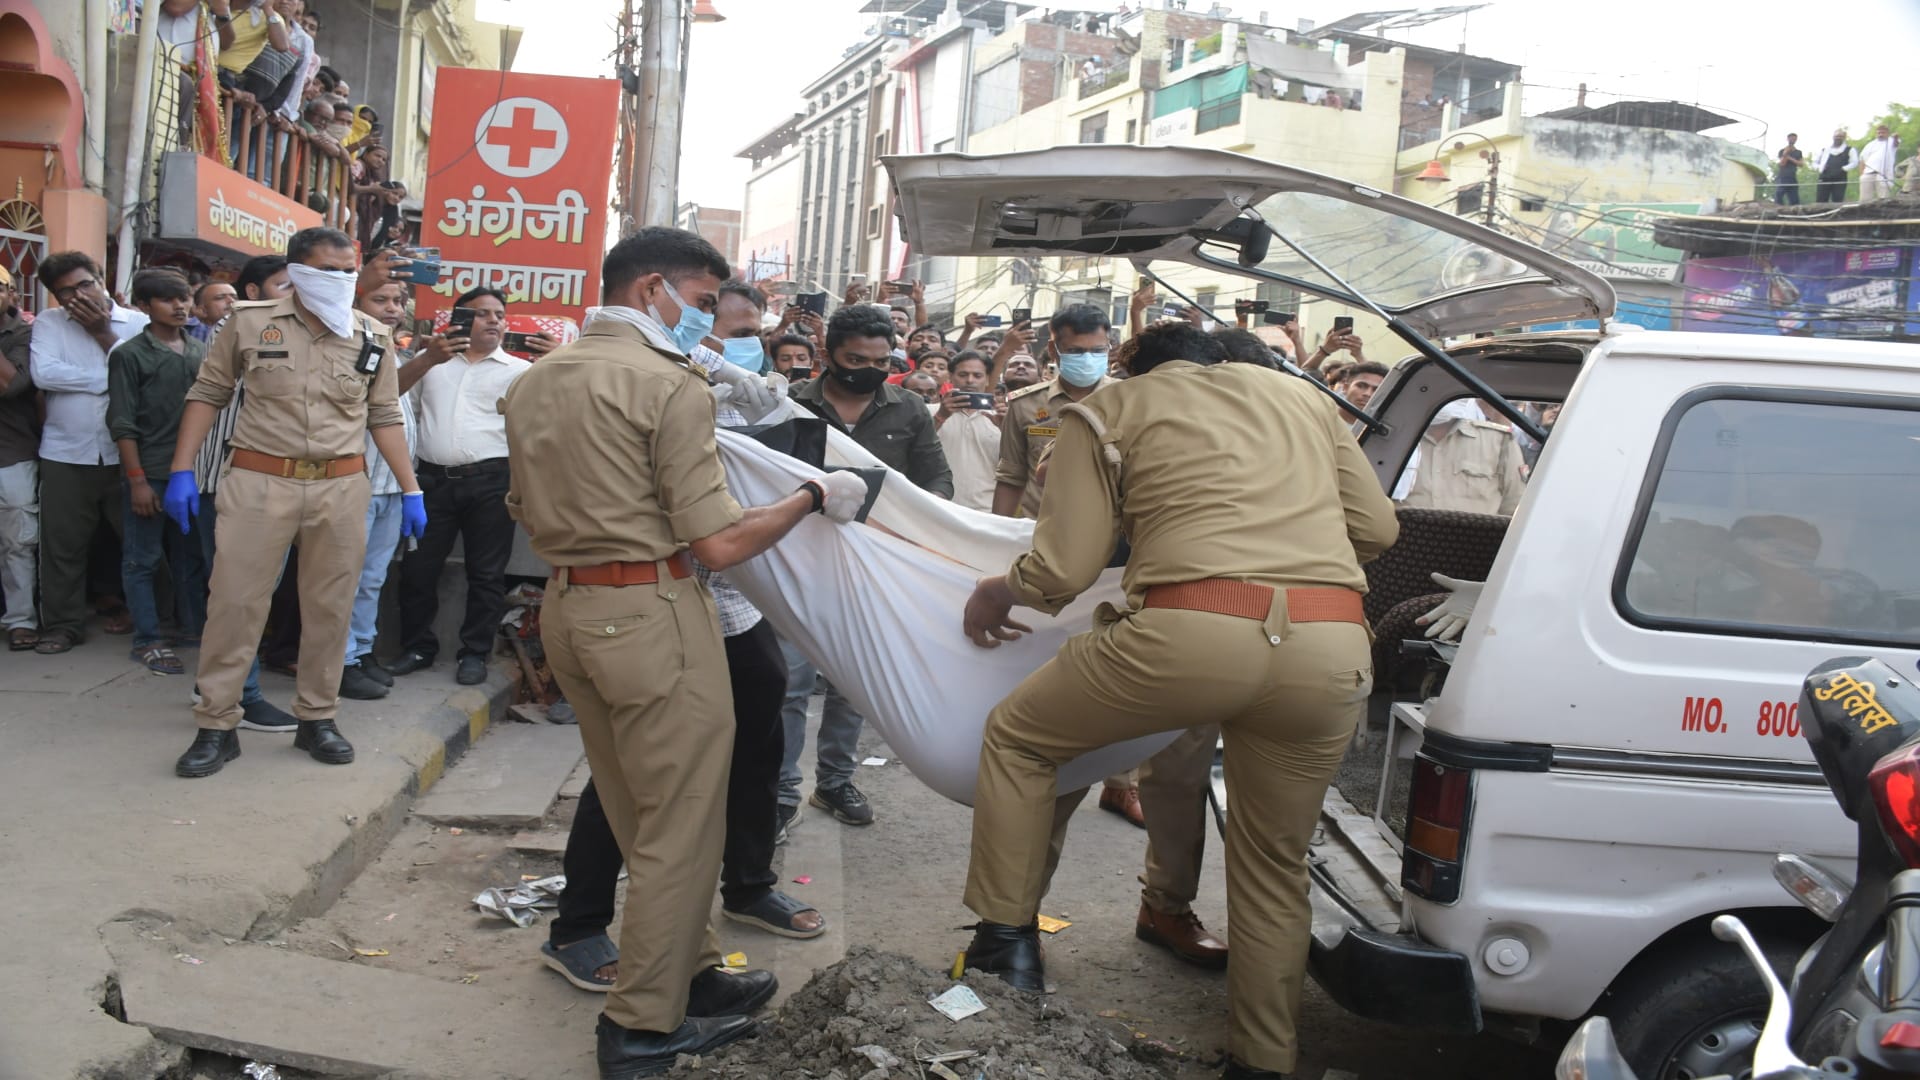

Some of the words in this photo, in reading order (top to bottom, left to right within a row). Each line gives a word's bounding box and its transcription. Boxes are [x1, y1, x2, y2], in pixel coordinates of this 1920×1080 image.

[208, 187, 267, 249] नेशनल
[437, 184, 590, 247] अंग्रेजी
[431, 260, 587, 306] दवाखाना
[1617, 265, 1669, 278] HOUSE
[1681, 697, 1727, 733] MO.
[1757, 701, 1806, 738] 800
[1815, 672, 1898, 734] पुलिस
